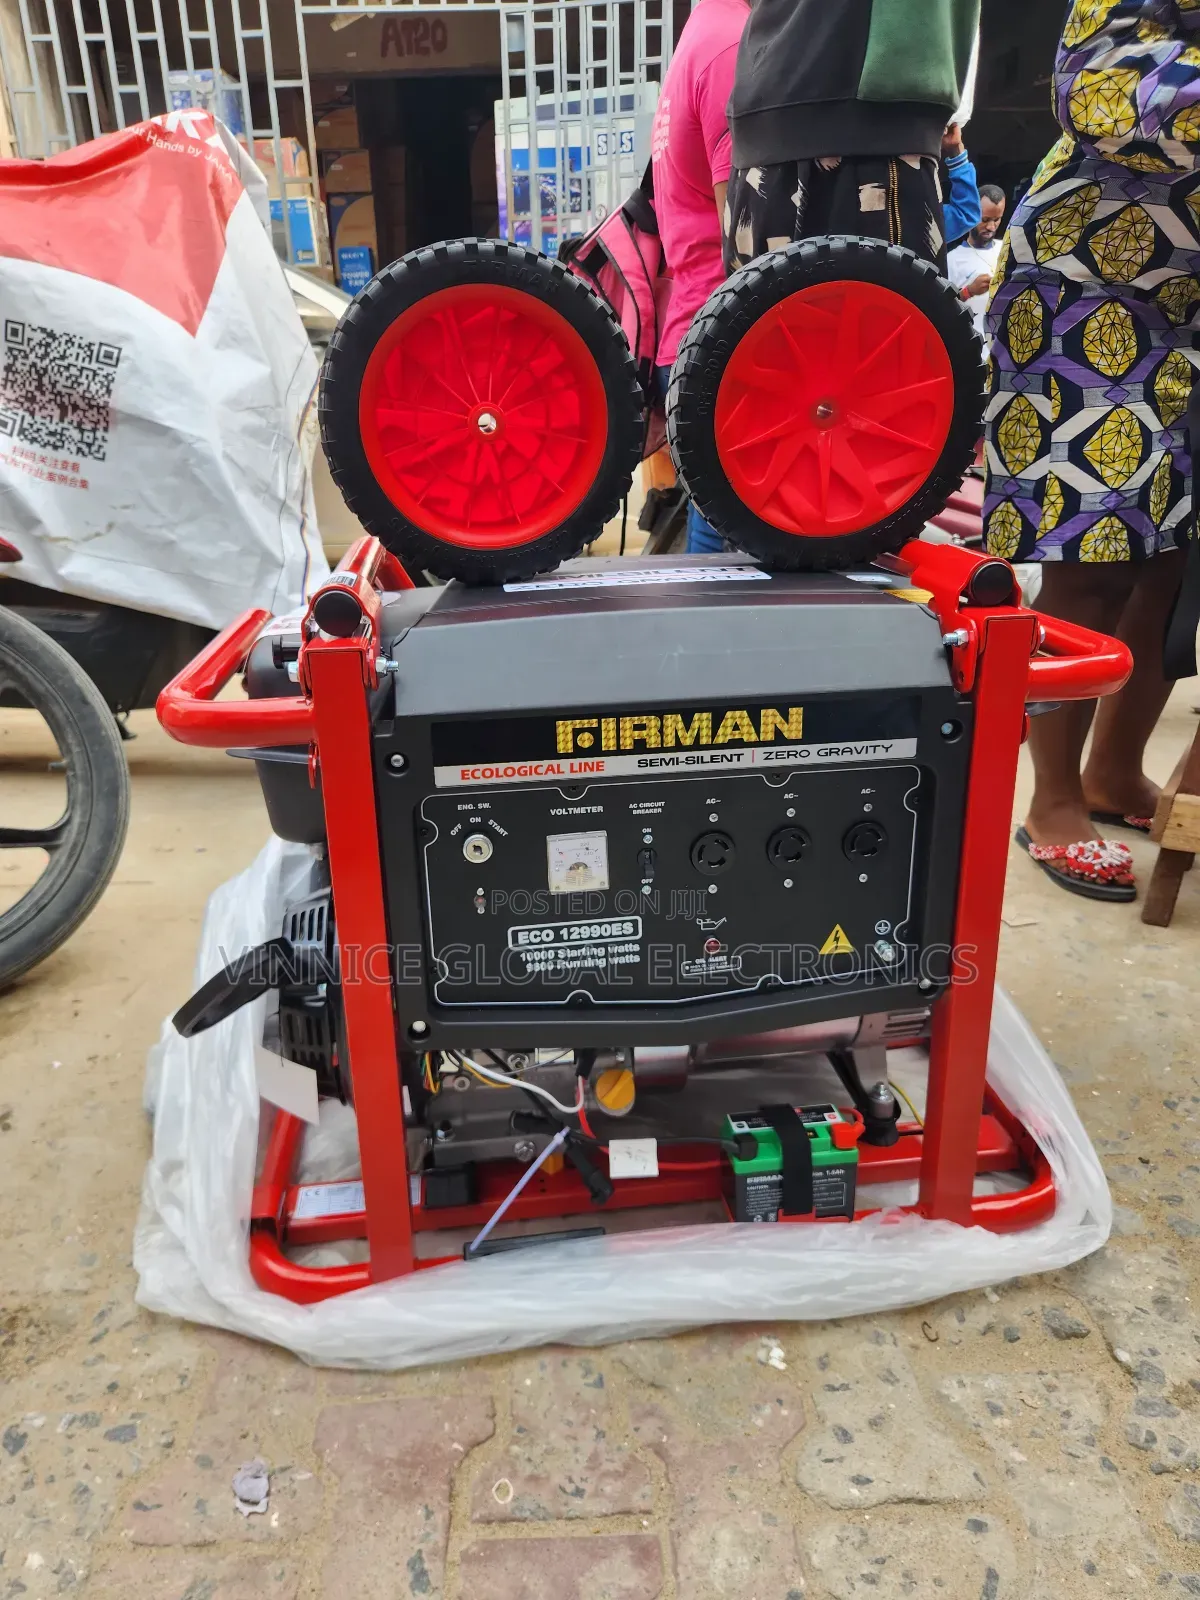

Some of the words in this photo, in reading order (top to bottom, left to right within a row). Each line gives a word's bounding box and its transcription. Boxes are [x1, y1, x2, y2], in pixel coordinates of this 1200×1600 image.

[146, 131, 185, 153] Hands
[187, 144, 203, 157] by
[555, 706, 804, 754] FIRMAN
[637, 752, 745, 769] SEMI-SILENT
[762, 749, 811, 761] ZERO
[816, 743, 894, 757] GRAVITY
[460, 762, 565, 781] ECOLOGICAL
[569, 760, 605, 774] LINE
[457, 803, 476, 811] ENG.
[477, 802, 492, 810] SW.
[550, 805, 604, 815] VOLTMETER
[450, 823, 463, 836] OFF
[488, 819, 509, 837] START
[517, 928, 555, 945] ECO
[559, 921, 634, 941] 12990ES
[520, 949, 555, 962] 10000
[557, 945, 606, 959] Starting
[608, 942, 641, 954] watts
[556, 956, 607, 970] Running
[609, 953, 641, 965] watts
